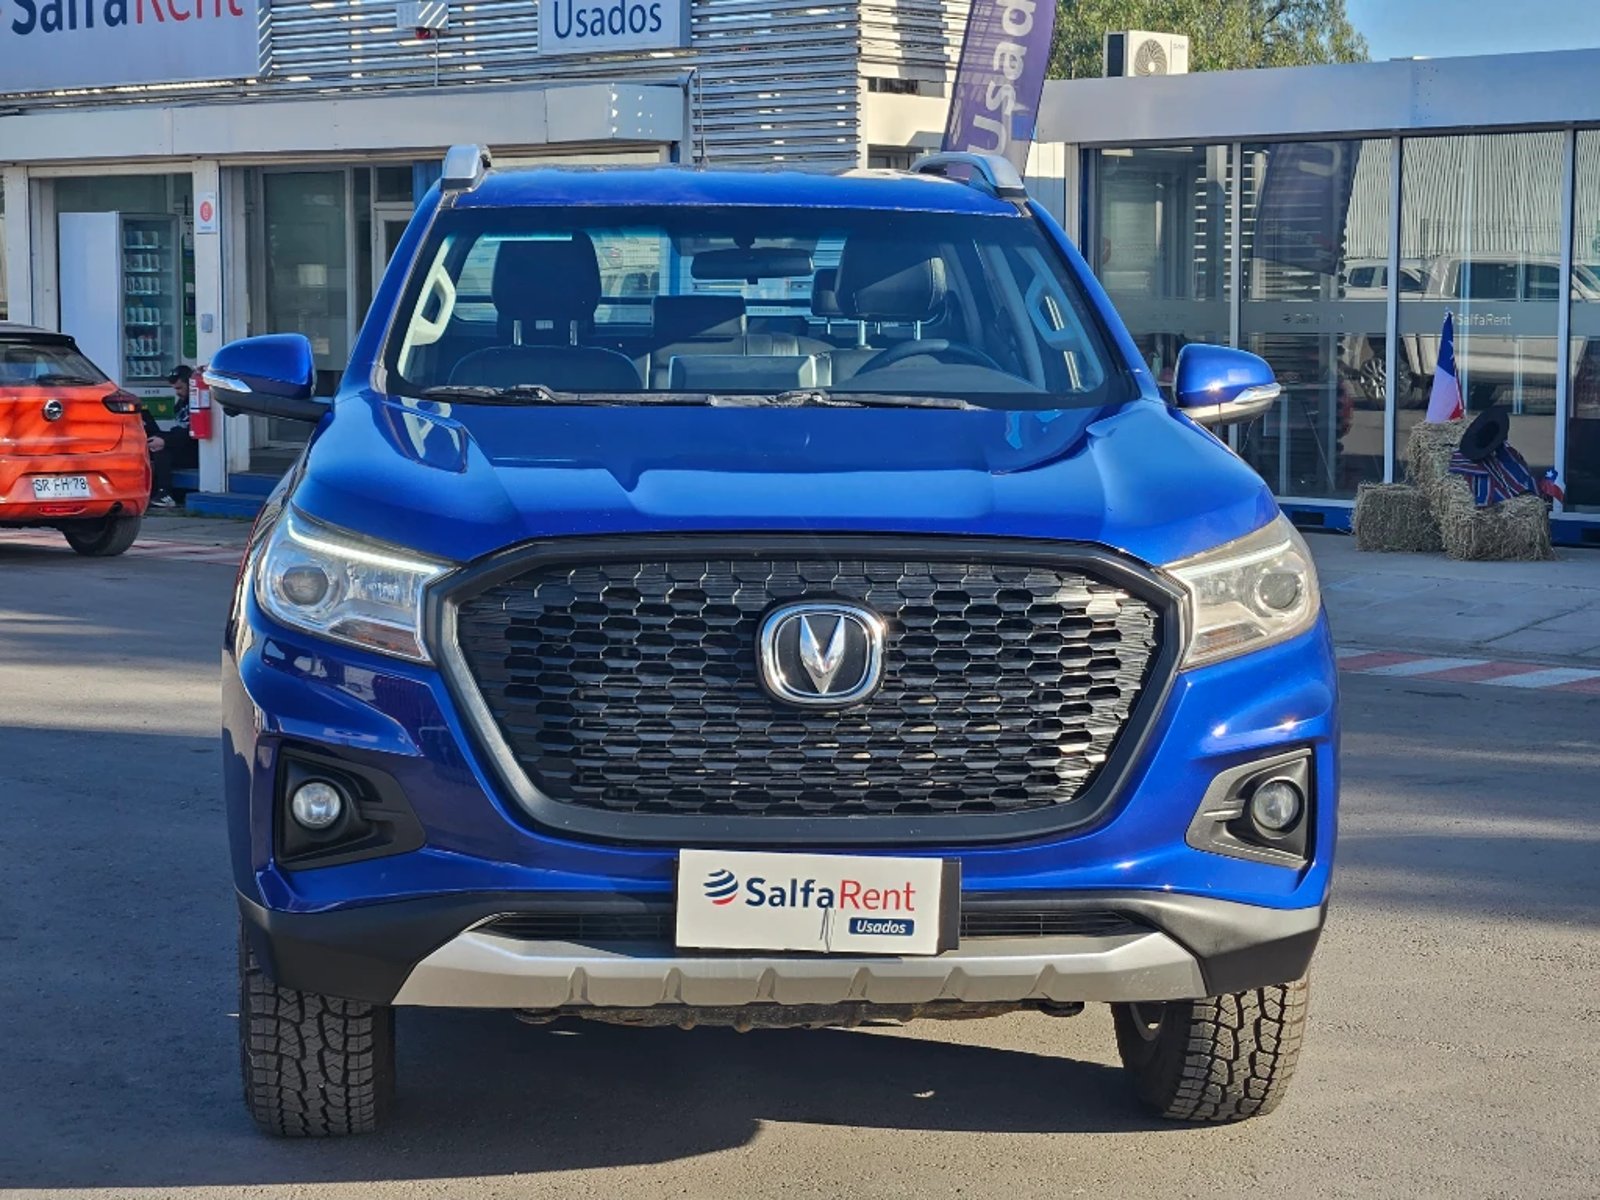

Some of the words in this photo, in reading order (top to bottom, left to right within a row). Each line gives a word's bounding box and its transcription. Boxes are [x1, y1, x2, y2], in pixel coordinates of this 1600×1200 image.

[554, 0, 662, 39] Usados
[35, 479, 51, 492] SR
[745, 876, 916, 912] SalfaRent
[857, 920, 906, 934] Usados
